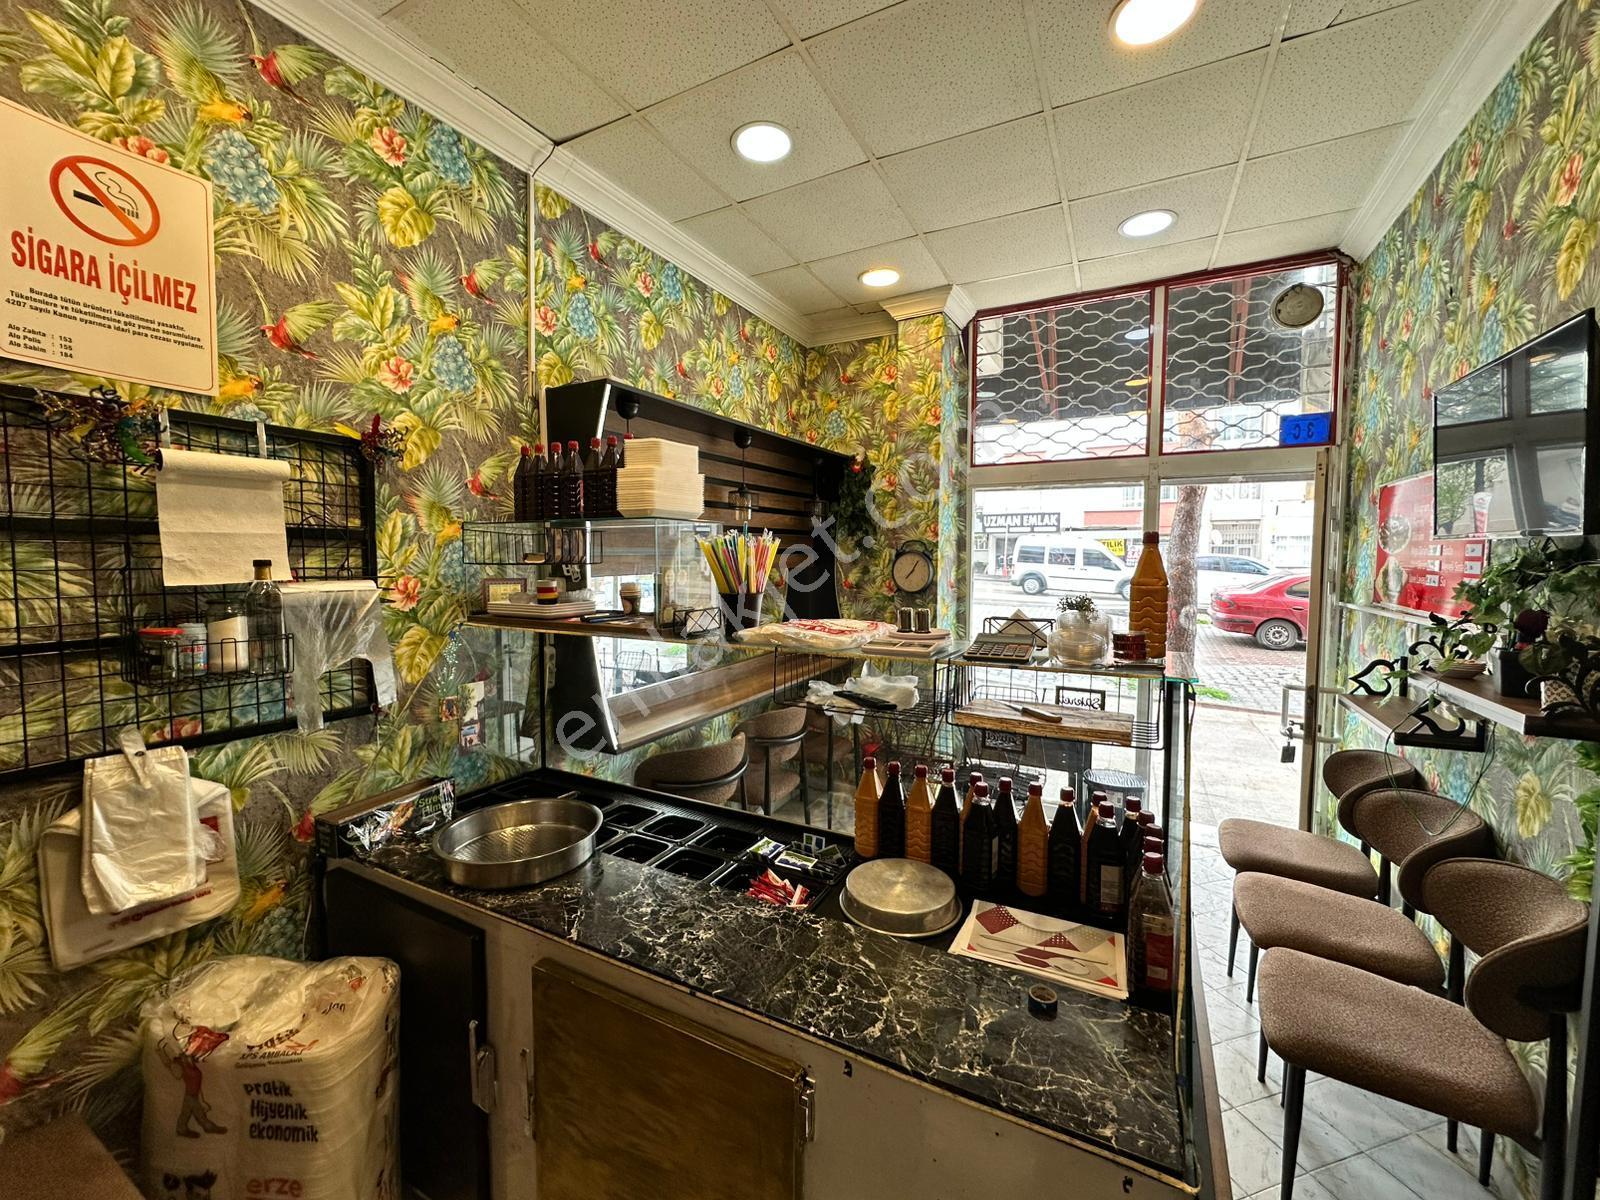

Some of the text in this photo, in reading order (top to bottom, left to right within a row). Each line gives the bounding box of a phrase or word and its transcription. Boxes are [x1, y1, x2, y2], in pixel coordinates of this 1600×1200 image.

[10, 226, 198, 314] SİGARA İÇİLMEZ
[5, 297, 27, 308] 4207
[52, 310, 77, 321] Kanun
[9, 290, 58, 308] Tüketenlere
[60, 304, 69, 312] ve
[29, 287, 58, 301] Burada
[60, 295, 81, 307] tütün
[82, 302, 112, 315] ürünleri
[983, 514, 1058, 527] UZMAN EMLAK
[249, 1122, 319, 1143] ekonomik
